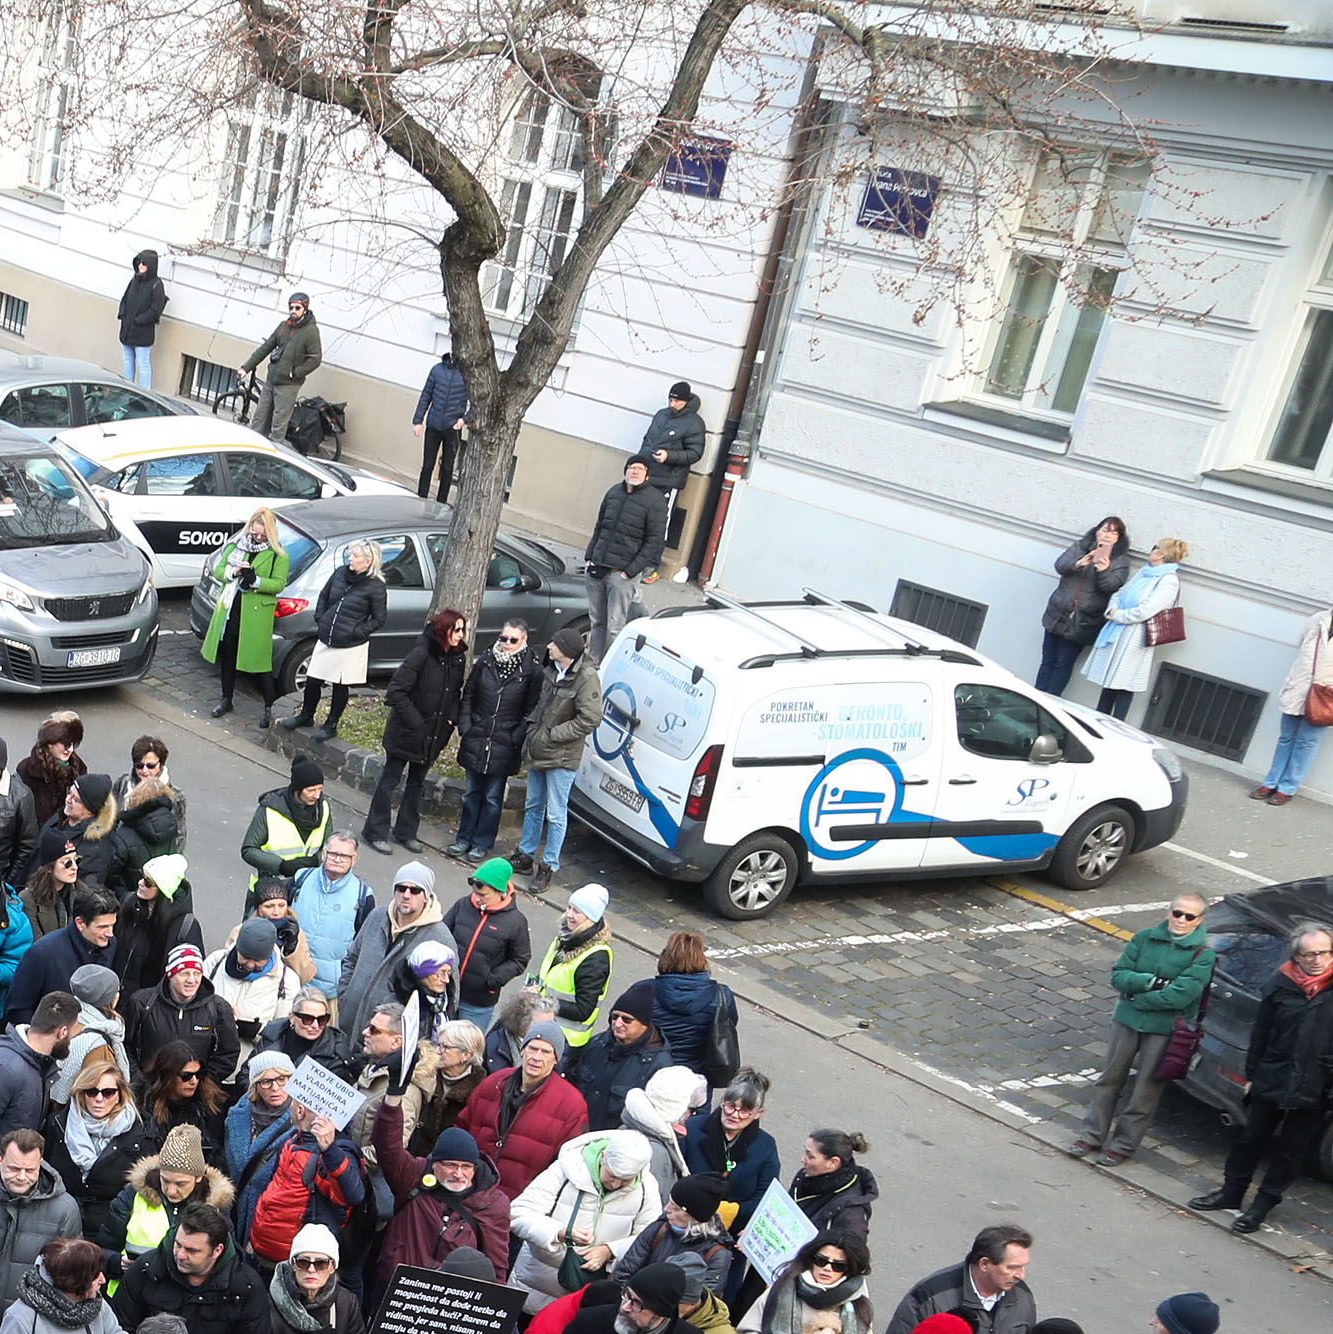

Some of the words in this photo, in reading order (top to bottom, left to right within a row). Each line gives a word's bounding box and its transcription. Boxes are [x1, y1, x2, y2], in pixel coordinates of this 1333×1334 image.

[74, 652, 85, 665] ZG
[770, 701, 815, 713] POKRETAN
[760, 710, 828, 724] SPECIJALISTIČKI
[892, 741, 907, 752] TIM
[305, 1074, 347, 1106] VLADIMIRA
[310, 1065, 326, 1078] TKO
[326, 1076, 335, 1084] JE
[335, 1081, 355, 1098] UBIO
[296, 1093, 313, 1107] ZNA
[313, 1104, 324, 1113] SE
[399, 1277, 431, 1289] Zanima
[444, 1288, 475, 1300] postoji
[475, 1292, 482, 1300] li
[394, 1289, 439, 1303] mogućnost
[439, 1297, 450, 1306] da
[472, 1306, 495, 1315] netko
[496, 1310, 507, 1318] da
[390, 1300, 403, 1308] me
[403, 1303, 439, 1315] pregleda
[440, 1309, 462, 1320] kući?
[462, 1314, 489, 1326] Barem
[490, 1321, 501, 1329] da
[380, 1323, 406, 1333] stanju
[407, 1327, 418, 1334] da
[414, 1316, 429, 1325] jer
[450, 1325, 475, 1334] nisam
